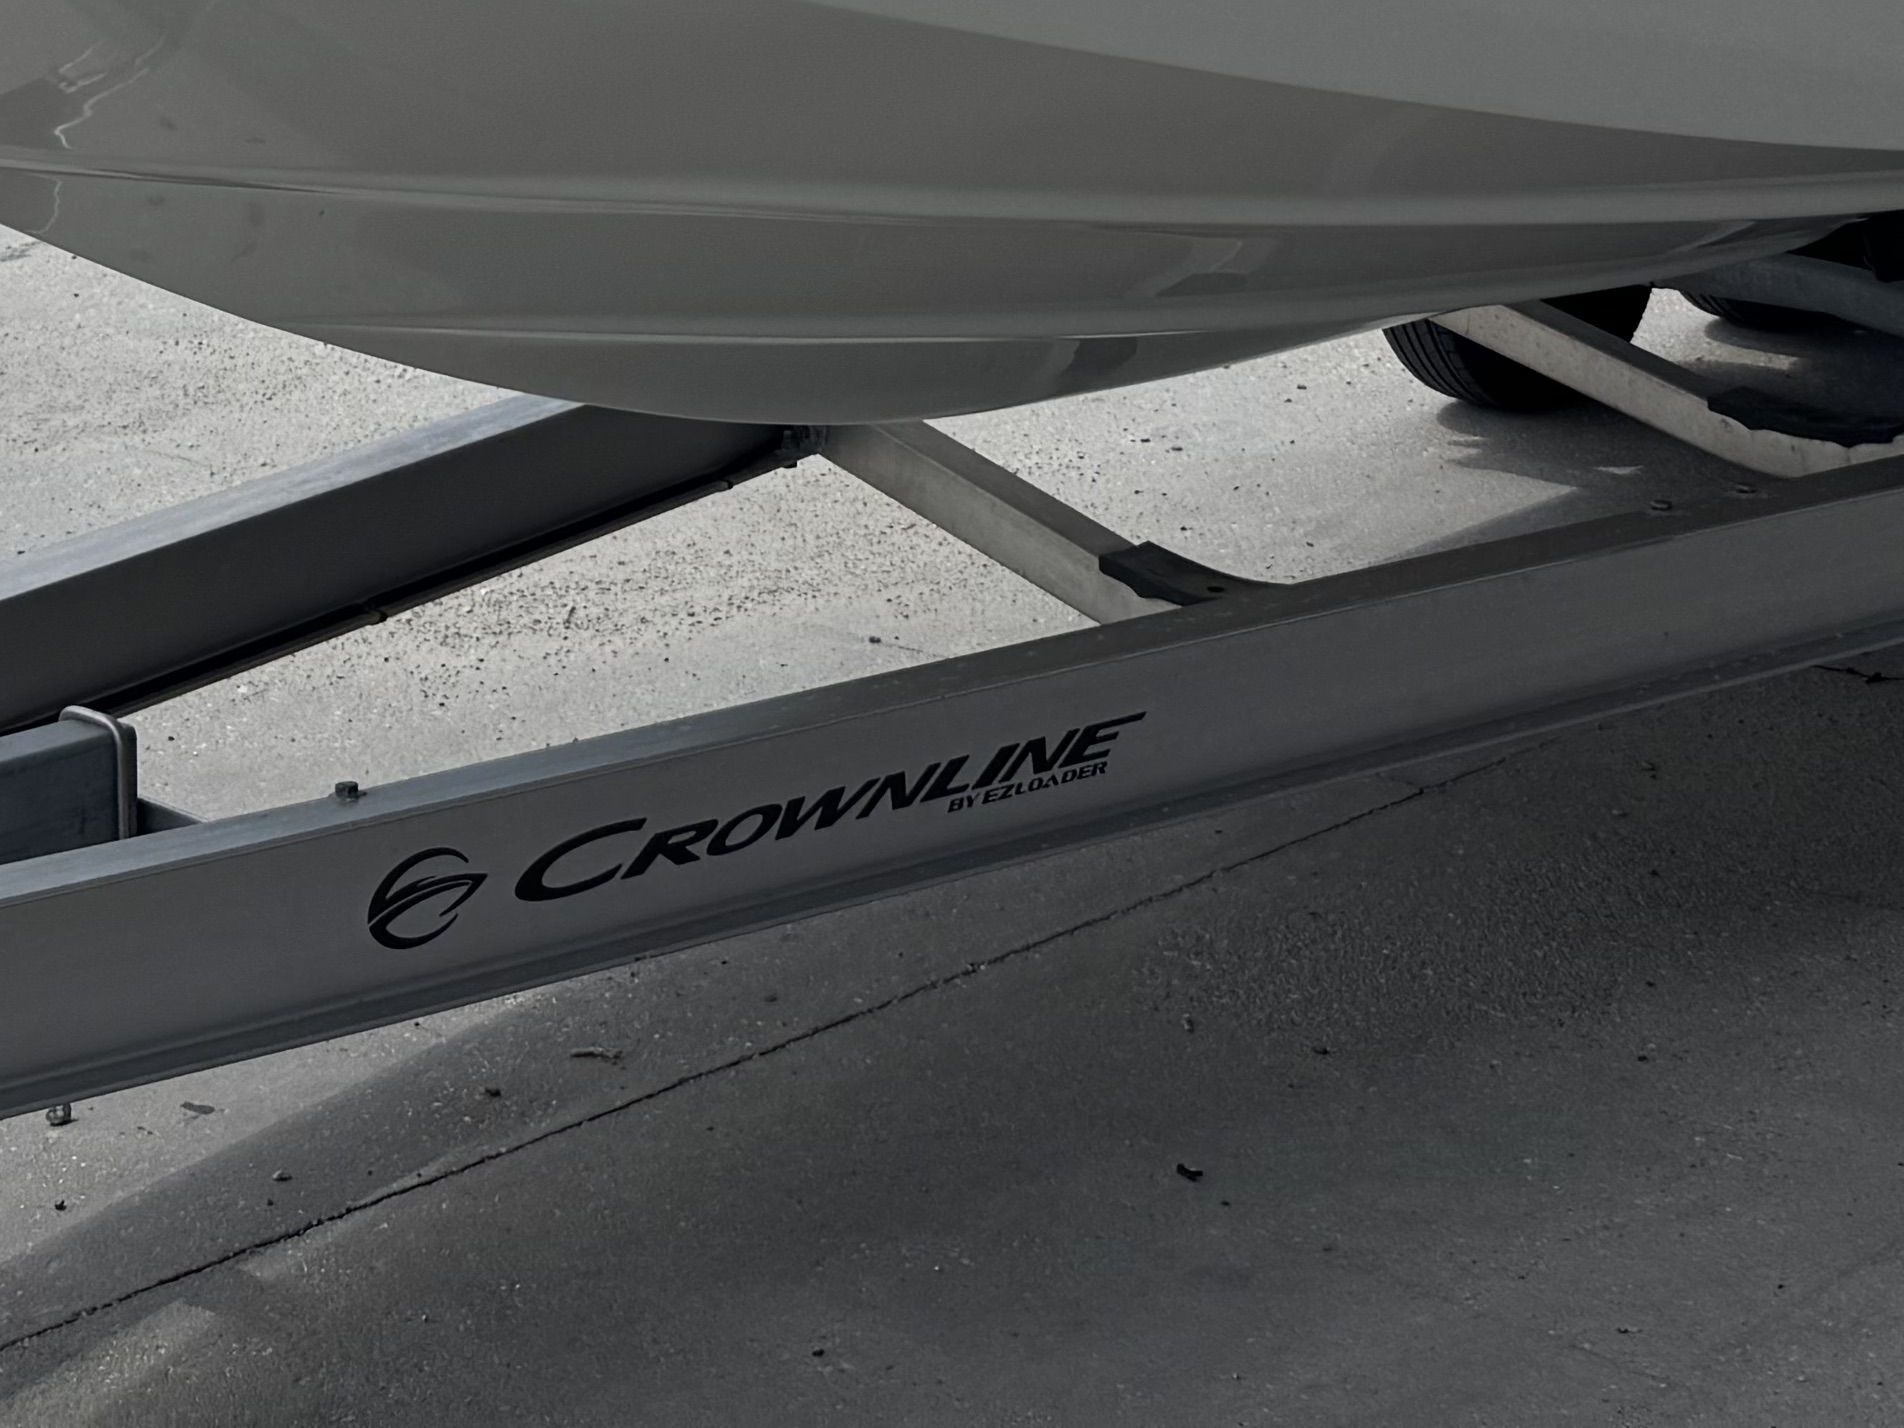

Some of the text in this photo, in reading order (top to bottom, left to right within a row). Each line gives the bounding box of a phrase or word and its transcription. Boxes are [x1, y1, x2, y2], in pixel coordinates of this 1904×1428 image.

[514, 710, 1148, 903] CROWNLINE
[947, 760, 1108, 814] BY EZLOADER
